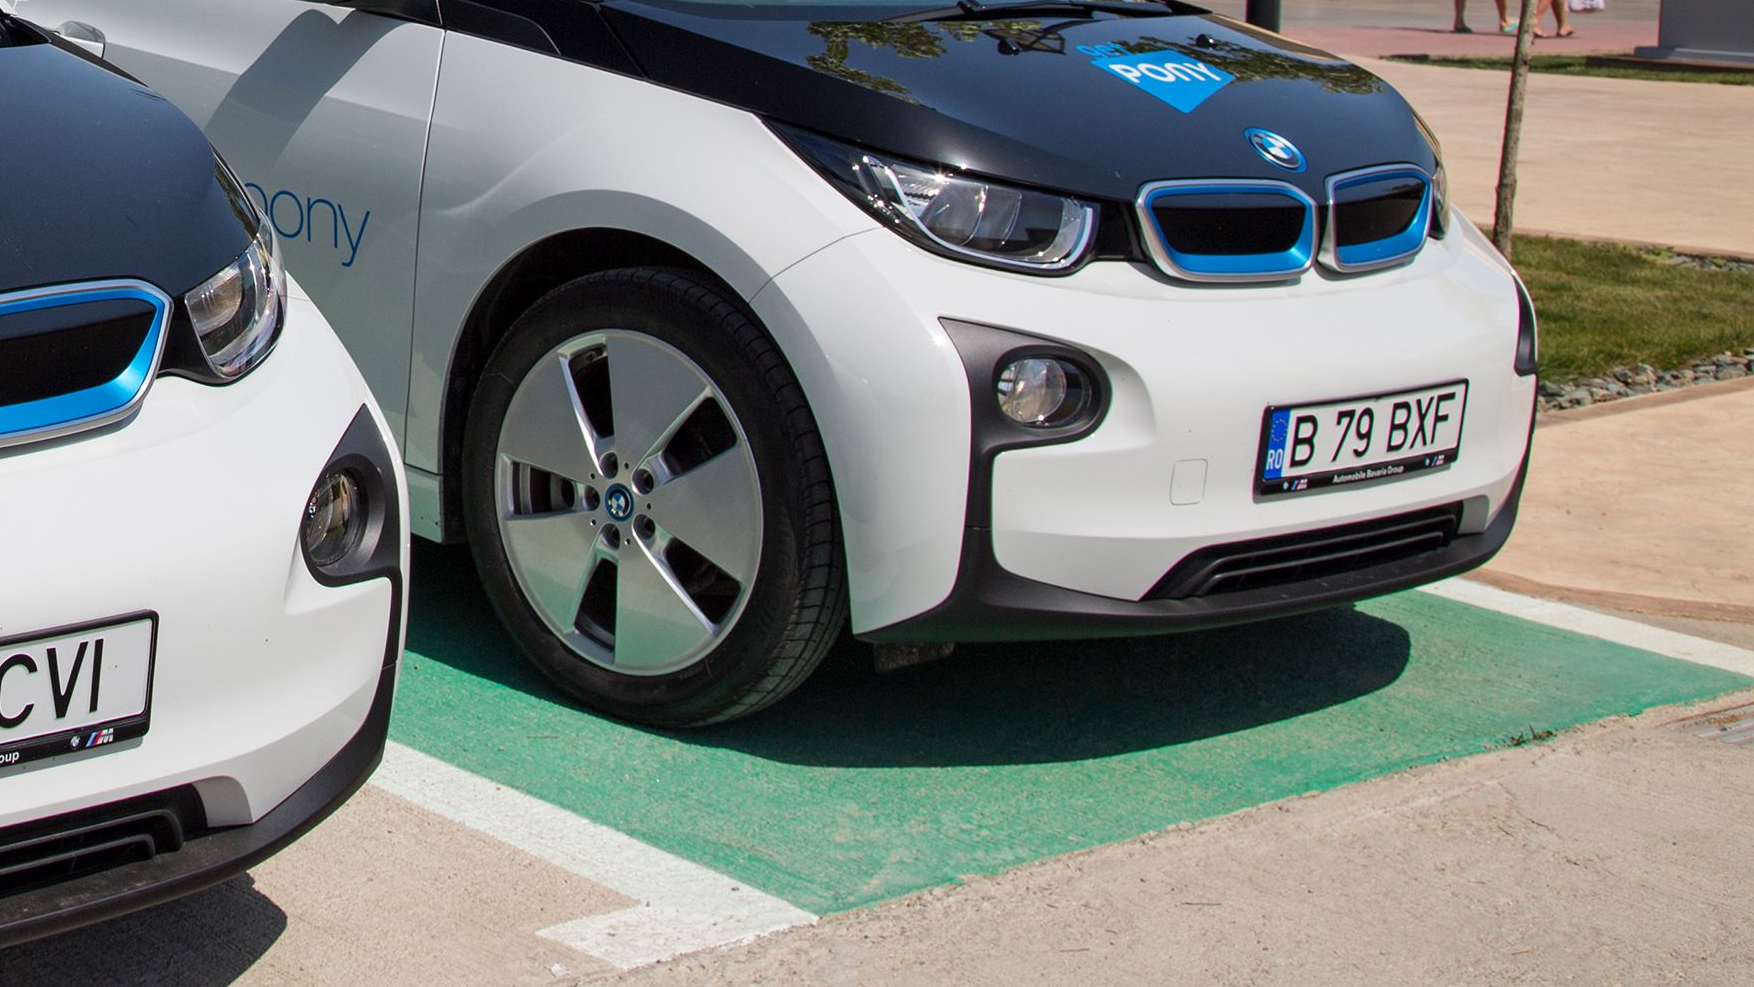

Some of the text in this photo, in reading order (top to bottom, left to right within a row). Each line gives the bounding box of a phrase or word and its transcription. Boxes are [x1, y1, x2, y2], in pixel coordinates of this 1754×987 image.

[1107, 61, 1223, 84] PONY
[1289, 391, 1457, 469] B 79 BXF
[1266, 448, 1284, 470] RO
